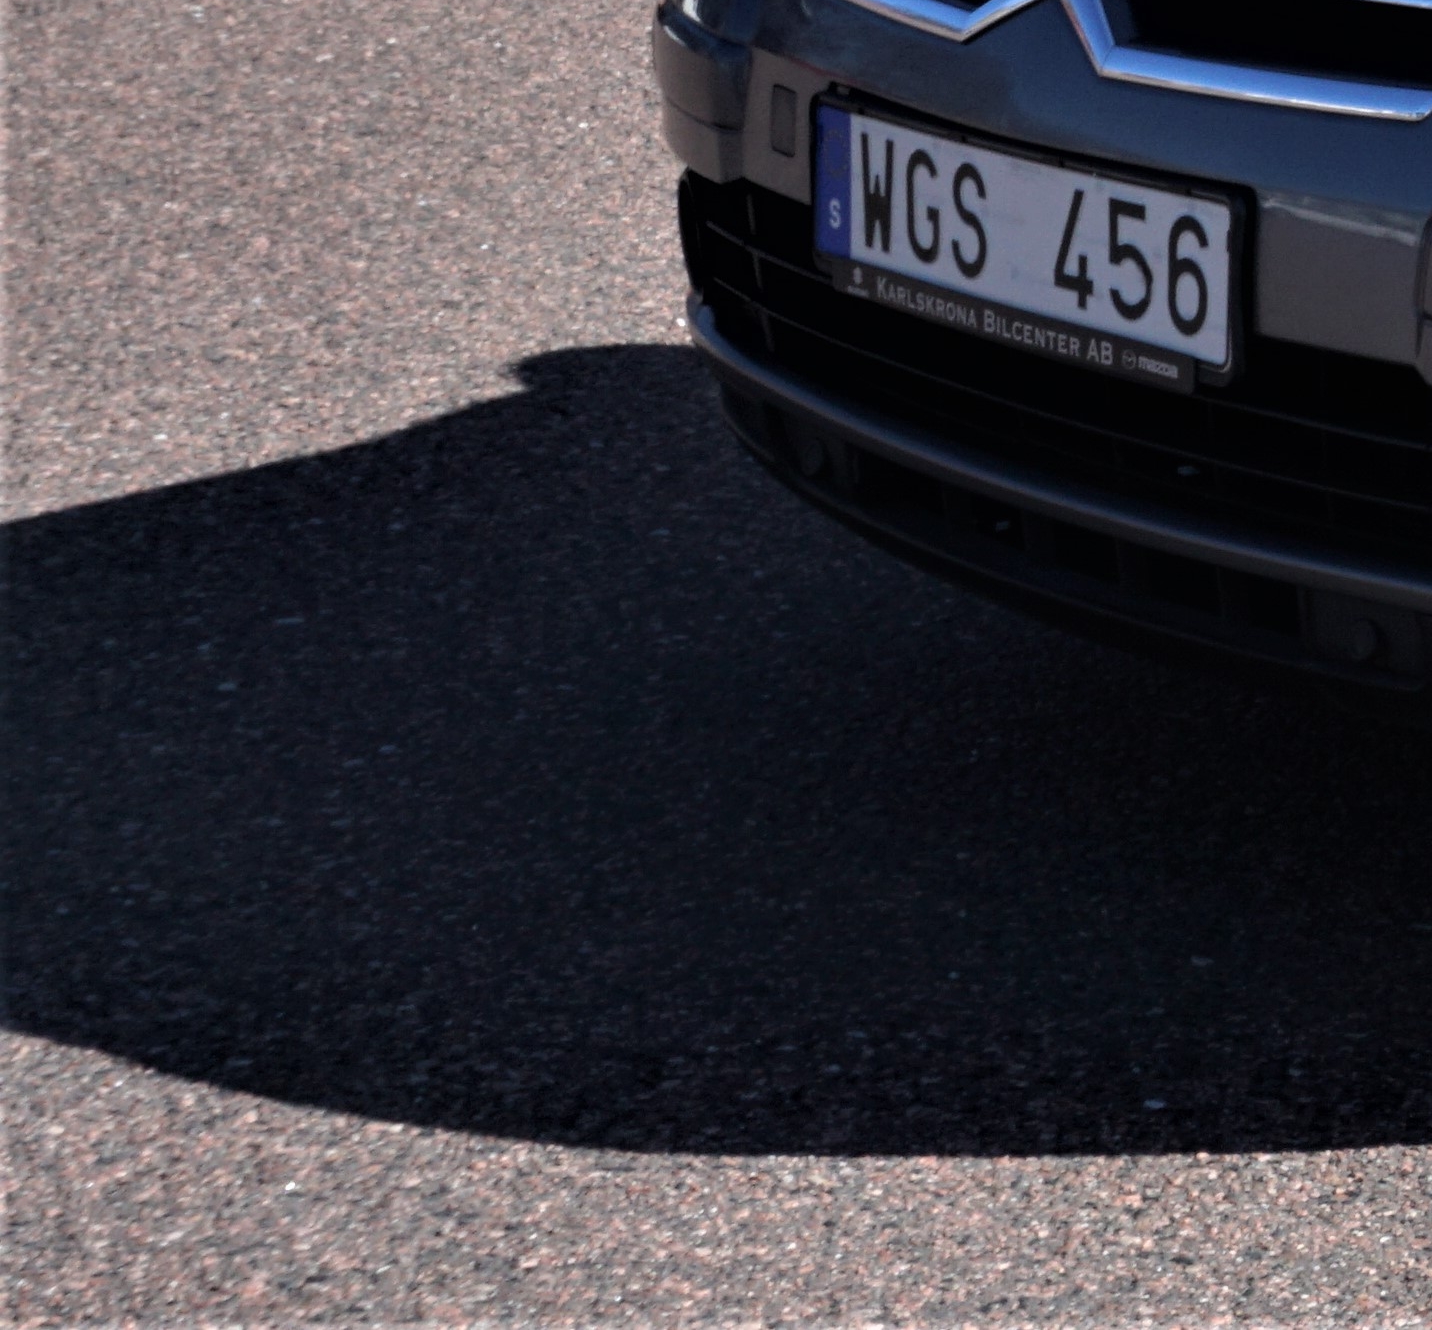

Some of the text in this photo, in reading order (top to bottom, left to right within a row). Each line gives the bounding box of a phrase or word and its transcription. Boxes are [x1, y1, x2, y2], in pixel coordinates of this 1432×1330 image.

[828, 198, 842, 230] S
[859, 130, 1210, 338] WGS 456
[1086, 335, 1114, 367] AB
